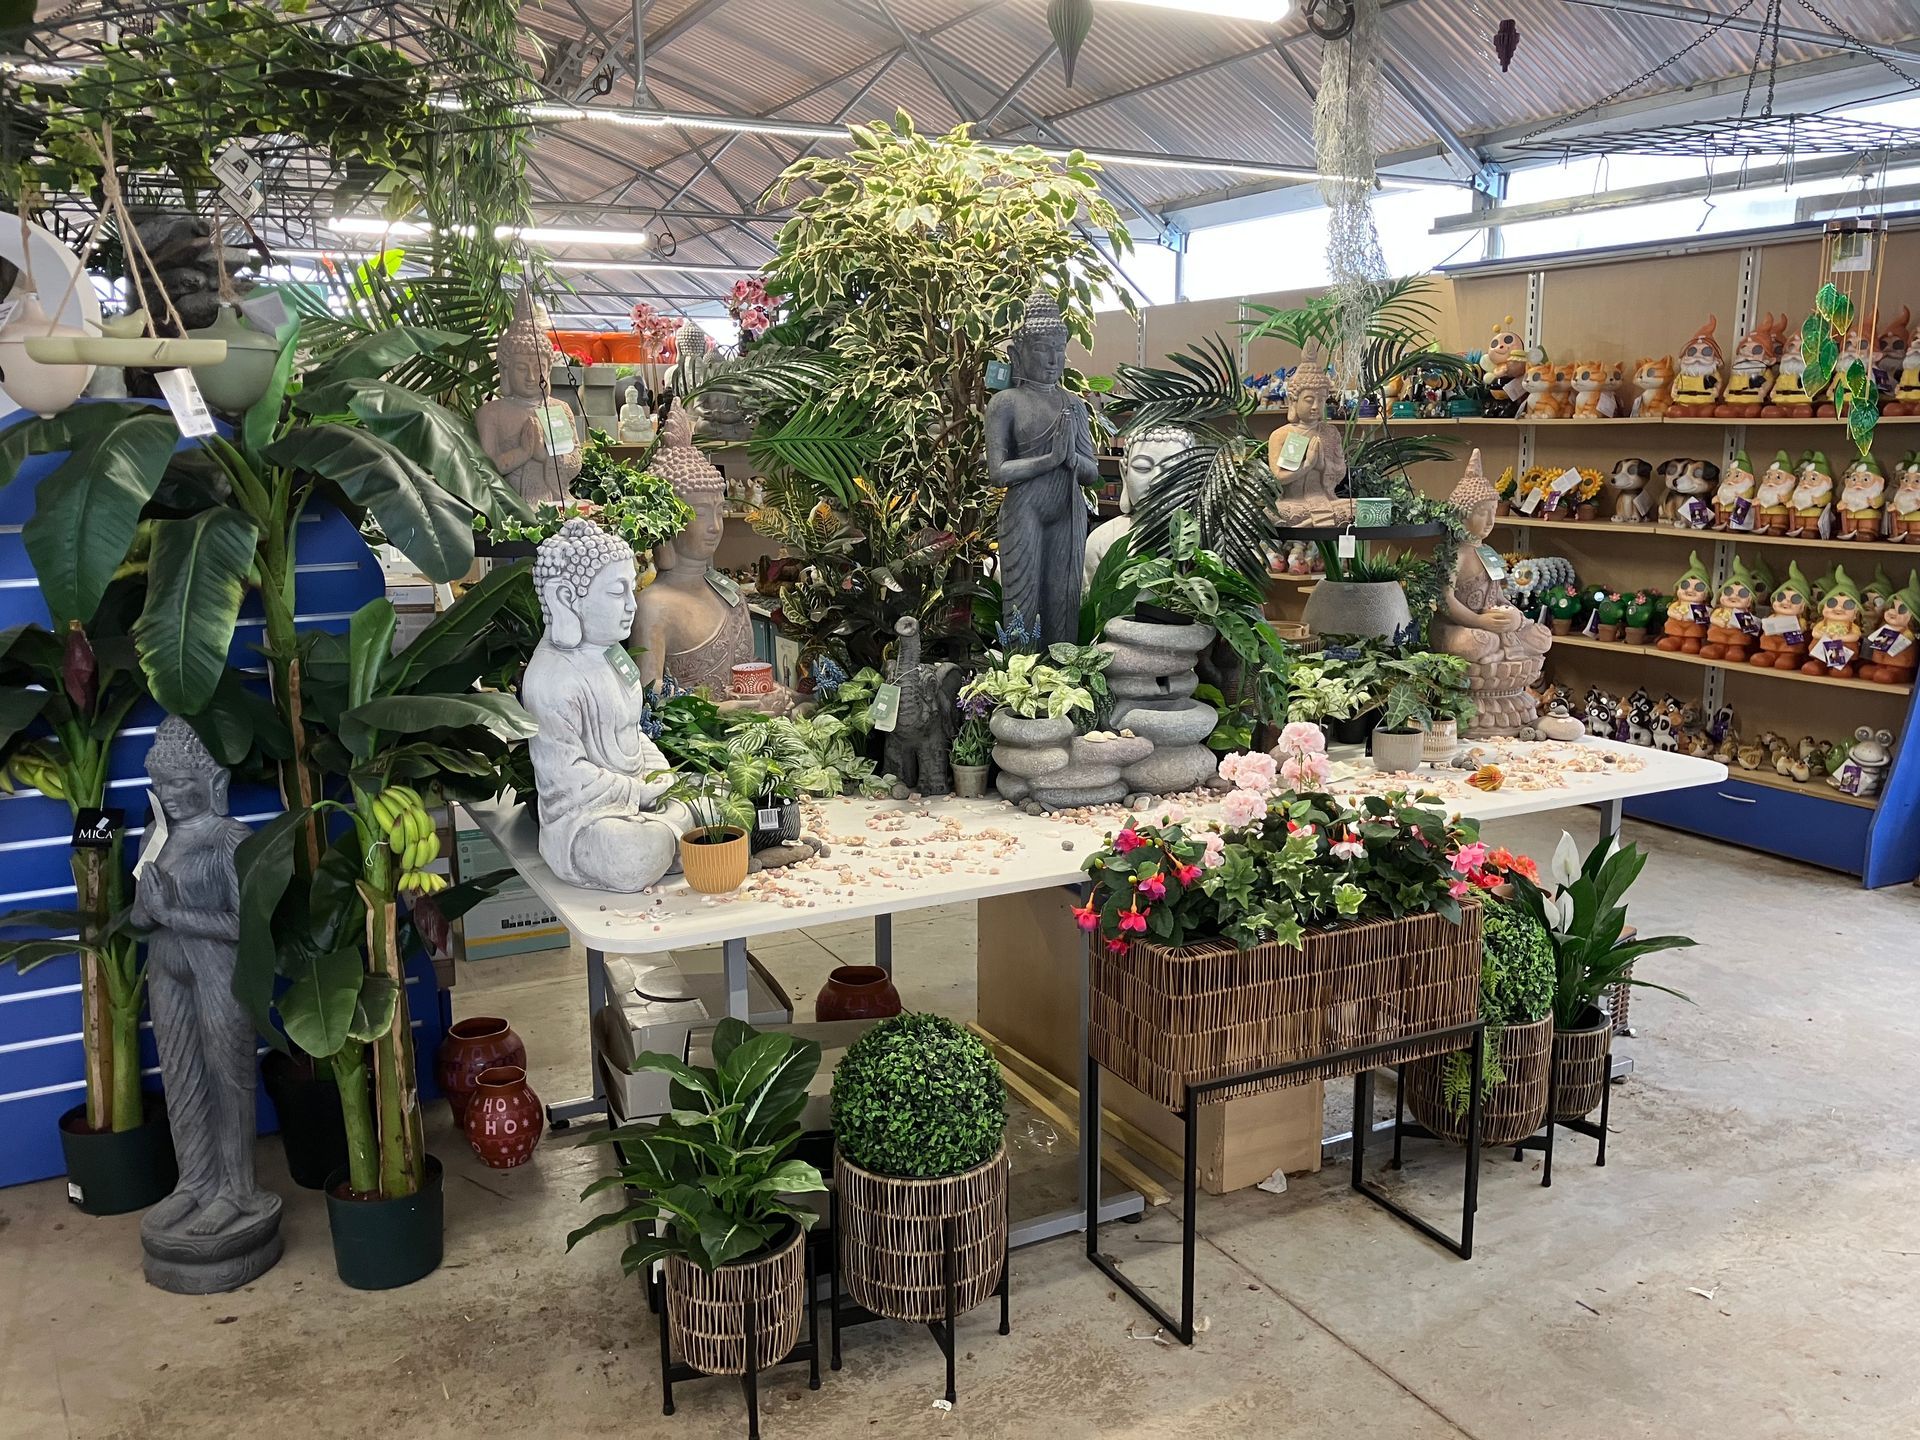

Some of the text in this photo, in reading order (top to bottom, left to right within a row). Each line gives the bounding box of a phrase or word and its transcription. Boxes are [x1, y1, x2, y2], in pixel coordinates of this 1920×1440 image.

[78, 828, 113, 839] MICA
[482, 1097, 507, 1114] HO
[485, 1120, 518, 1136] HO
